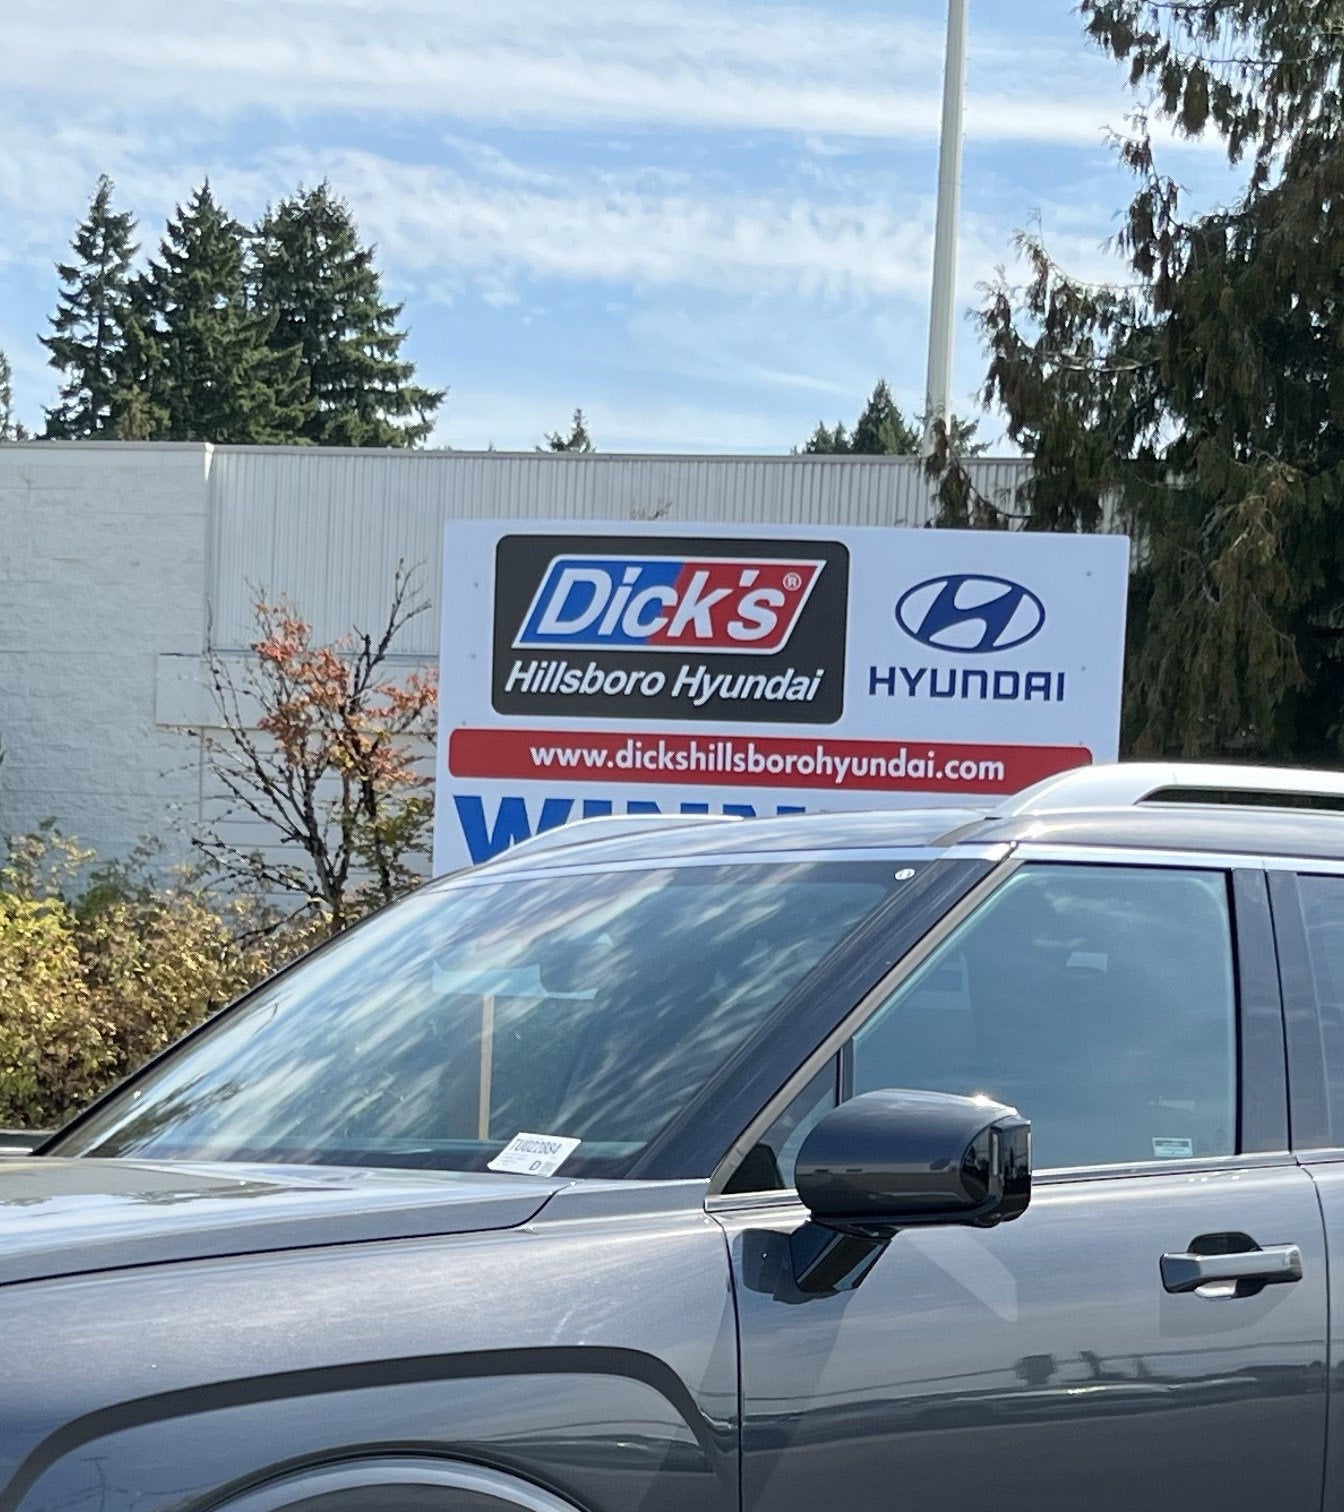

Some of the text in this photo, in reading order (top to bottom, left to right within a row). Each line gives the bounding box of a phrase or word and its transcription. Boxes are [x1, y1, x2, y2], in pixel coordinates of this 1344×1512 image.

[504, 659, 825, 706] Hillsboro Hyundai
[868, 665, 1066, 703] HYUNDAI
[529, 738, 1006, 785] www.dickshillsborohyundai.com
[528, 1160, 542, 1171] D
